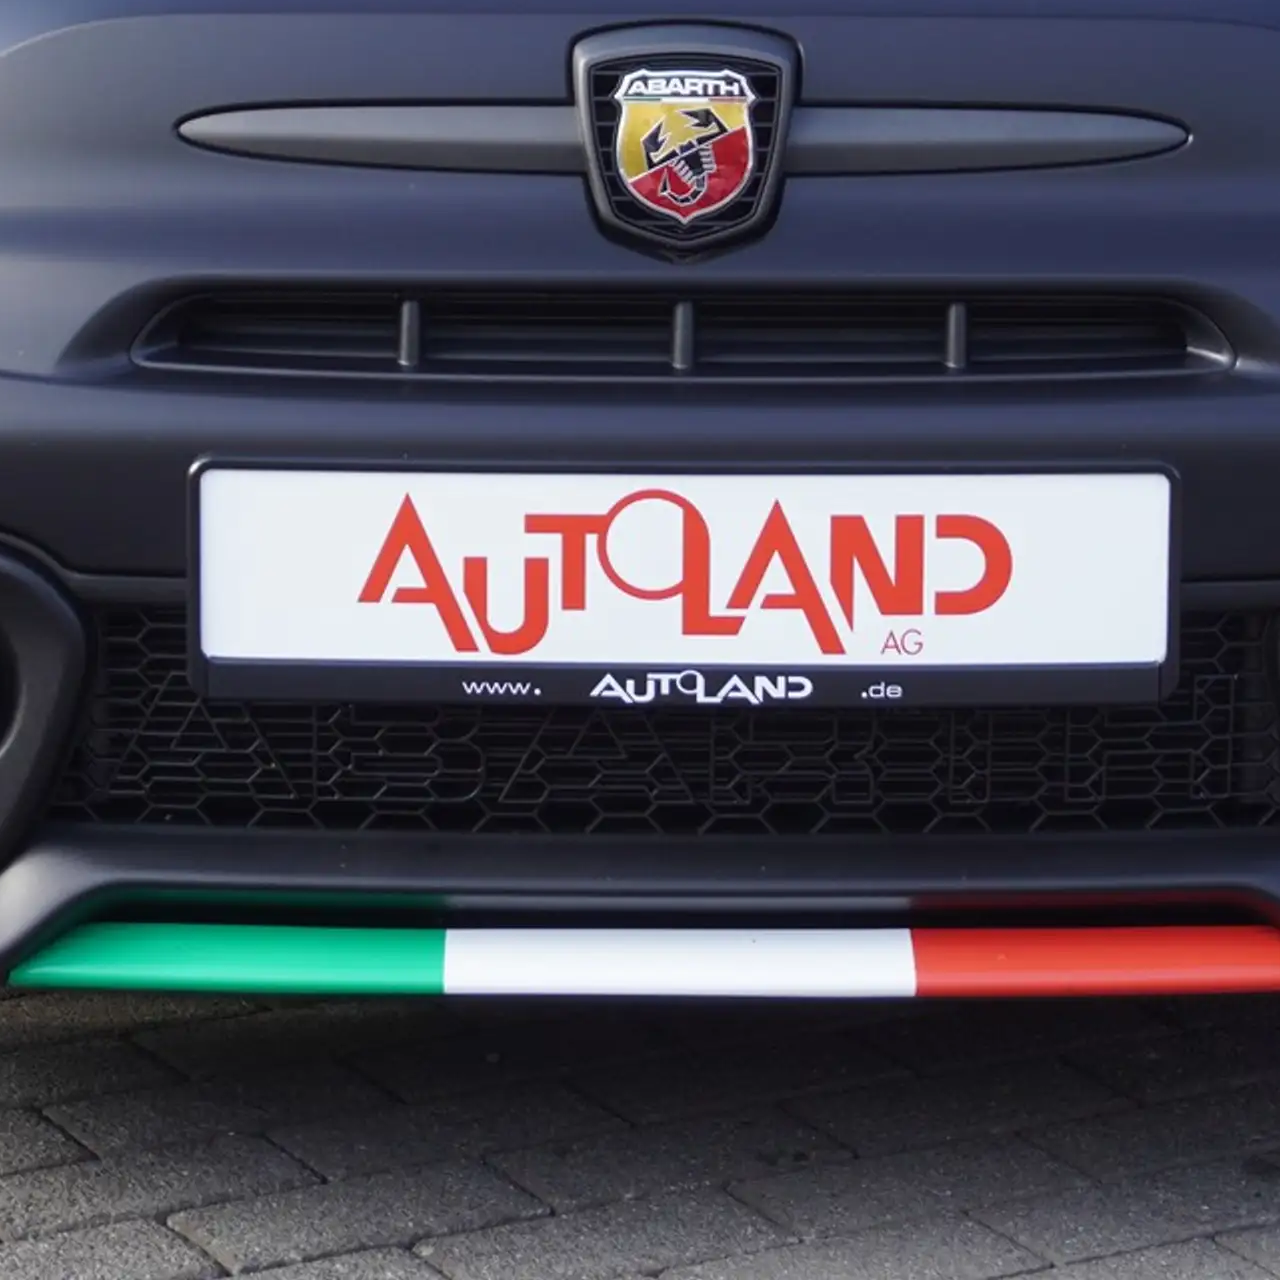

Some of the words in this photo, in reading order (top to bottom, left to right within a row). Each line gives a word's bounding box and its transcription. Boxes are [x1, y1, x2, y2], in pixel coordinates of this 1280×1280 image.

[628, 78, 739, 96] ABARTH
[357, 488, 1014, 656] AUTOLAND
[880, 628, 924, 656] AG
[462, 681, 542, 696] www.
[589, 670, 814, 705] AUTOLAND
[861, 682, 902, 698] .de
